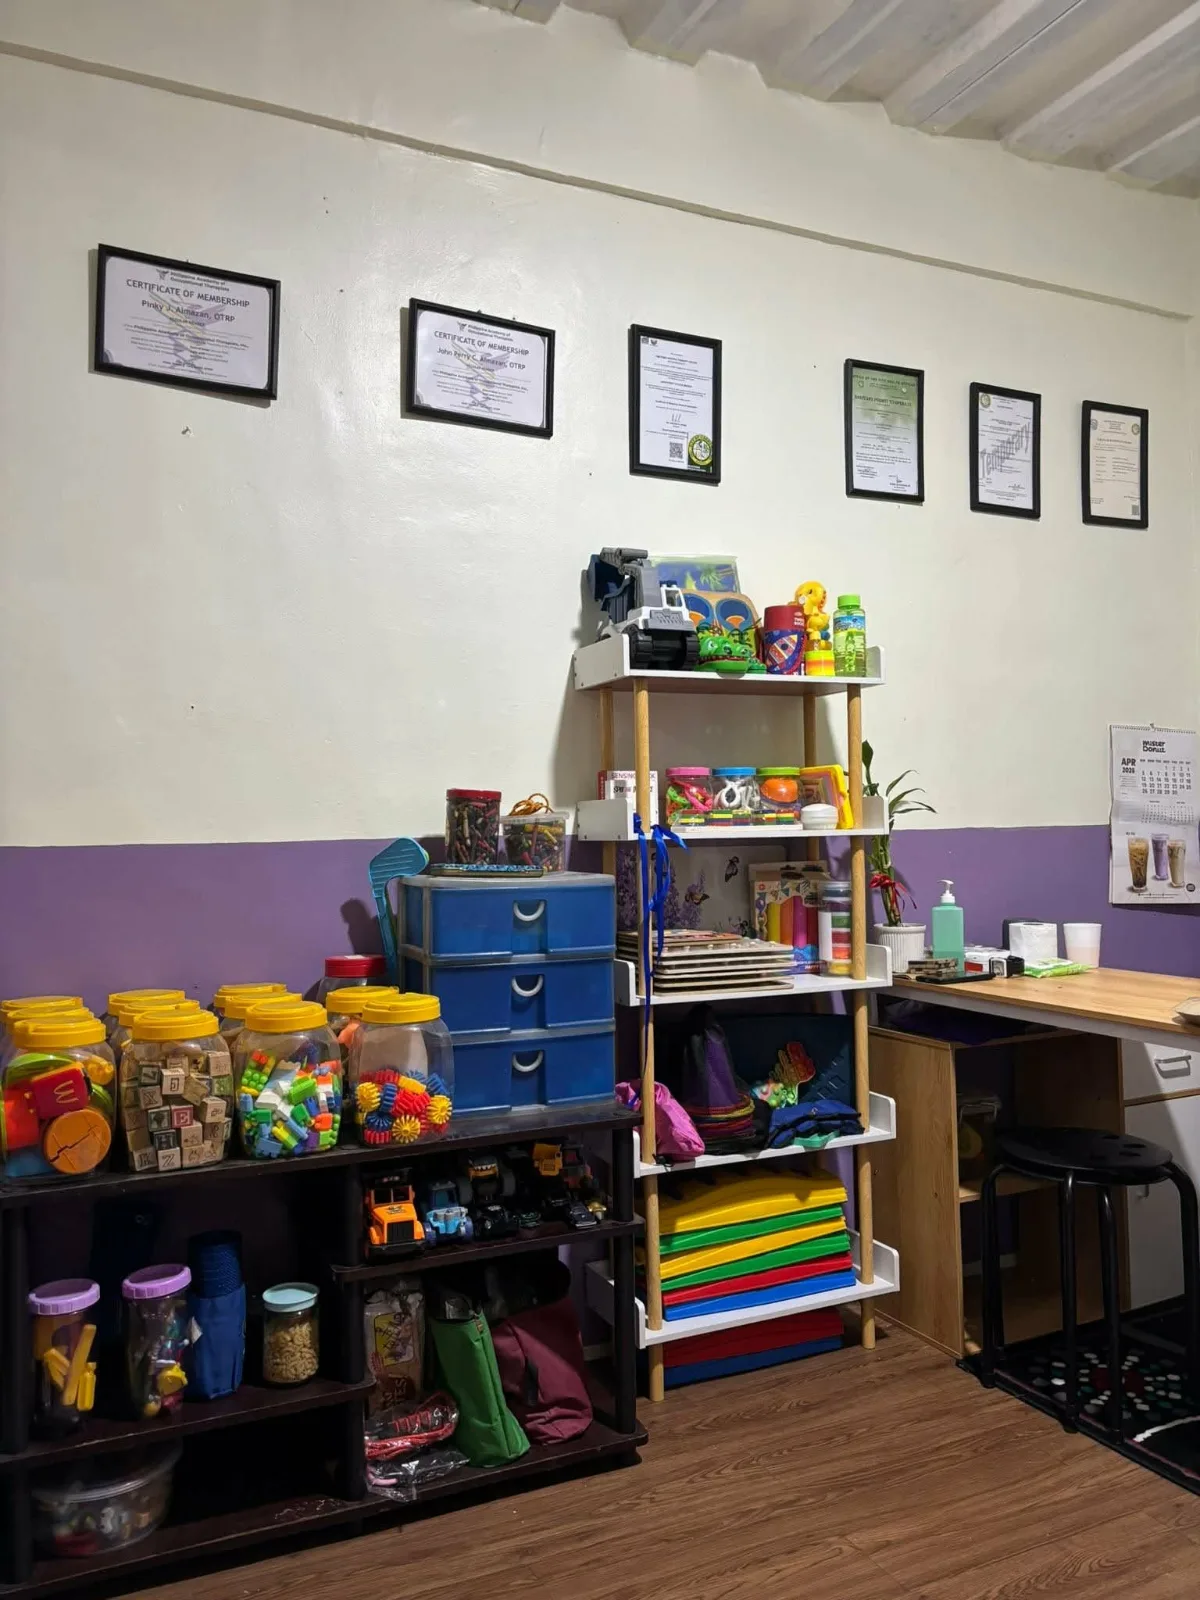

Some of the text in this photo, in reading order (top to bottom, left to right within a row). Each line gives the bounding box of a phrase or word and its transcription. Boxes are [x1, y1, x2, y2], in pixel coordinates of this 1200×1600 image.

[126, 279, 250, 307] CERTIFICATE OF MEMBERSHIP
[142, 300, 164, 311] Pinky
[214, 313, 235, 322] OTRP
[434, 331, 475, 345] CERTIFICATE
[488, 343, 530, 356] MEMBERSHIP
[437, 348, 453, 356] John
[453, 351, 470, 359] Perry
[509, 362, 526, 370] OTRP
[1122, 758, 1136, 766] APR
[162, 1154, 175, 1167] Z
